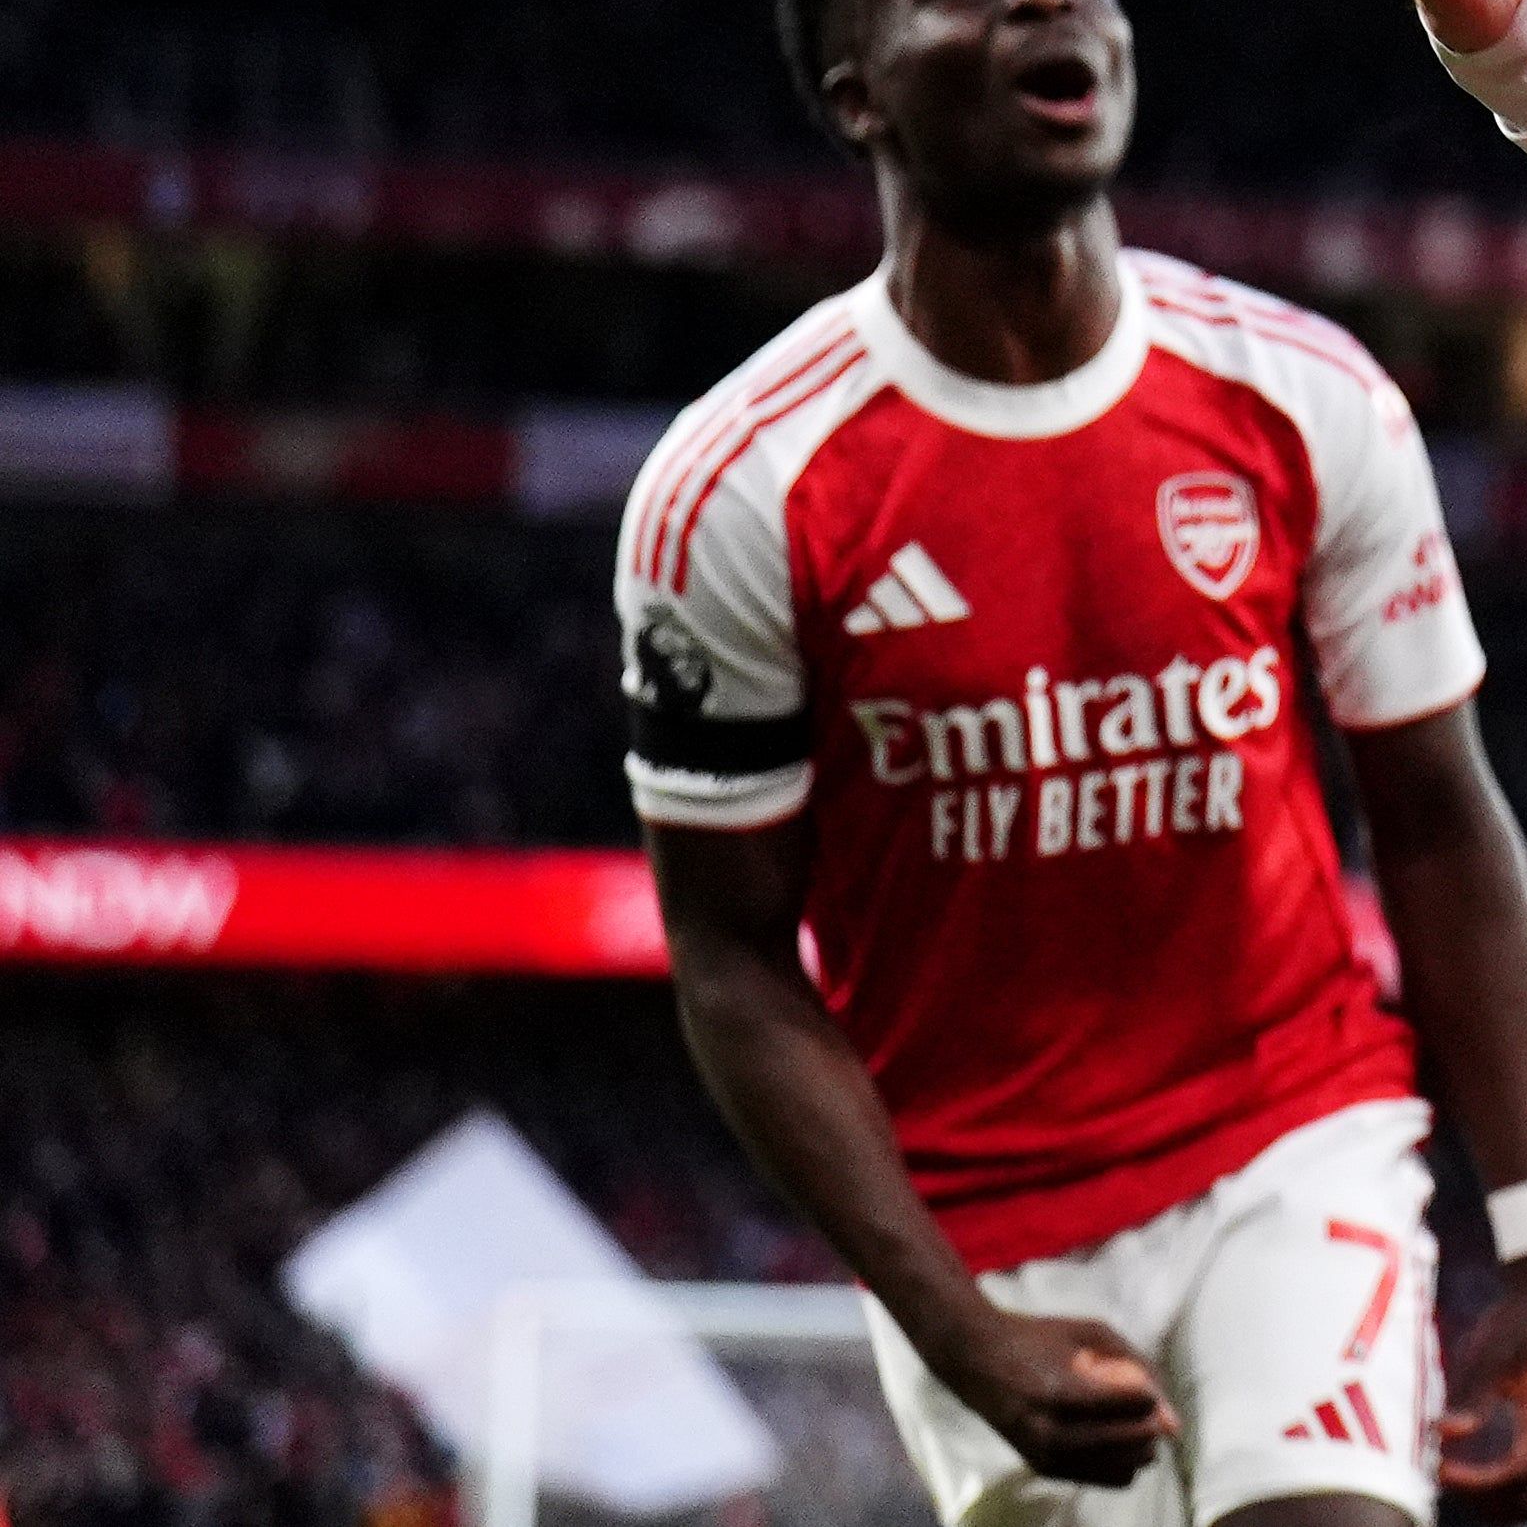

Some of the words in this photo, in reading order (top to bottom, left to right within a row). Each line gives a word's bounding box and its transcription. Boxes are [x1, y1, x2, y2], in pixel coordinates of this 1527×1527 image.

[849, 645, 1281, 786] Emirates
[930, 781, 1021, 863] FLY
[1036, 750, 1243, 857] BETTER
[1325, 1218, 1399, 1361] 7
